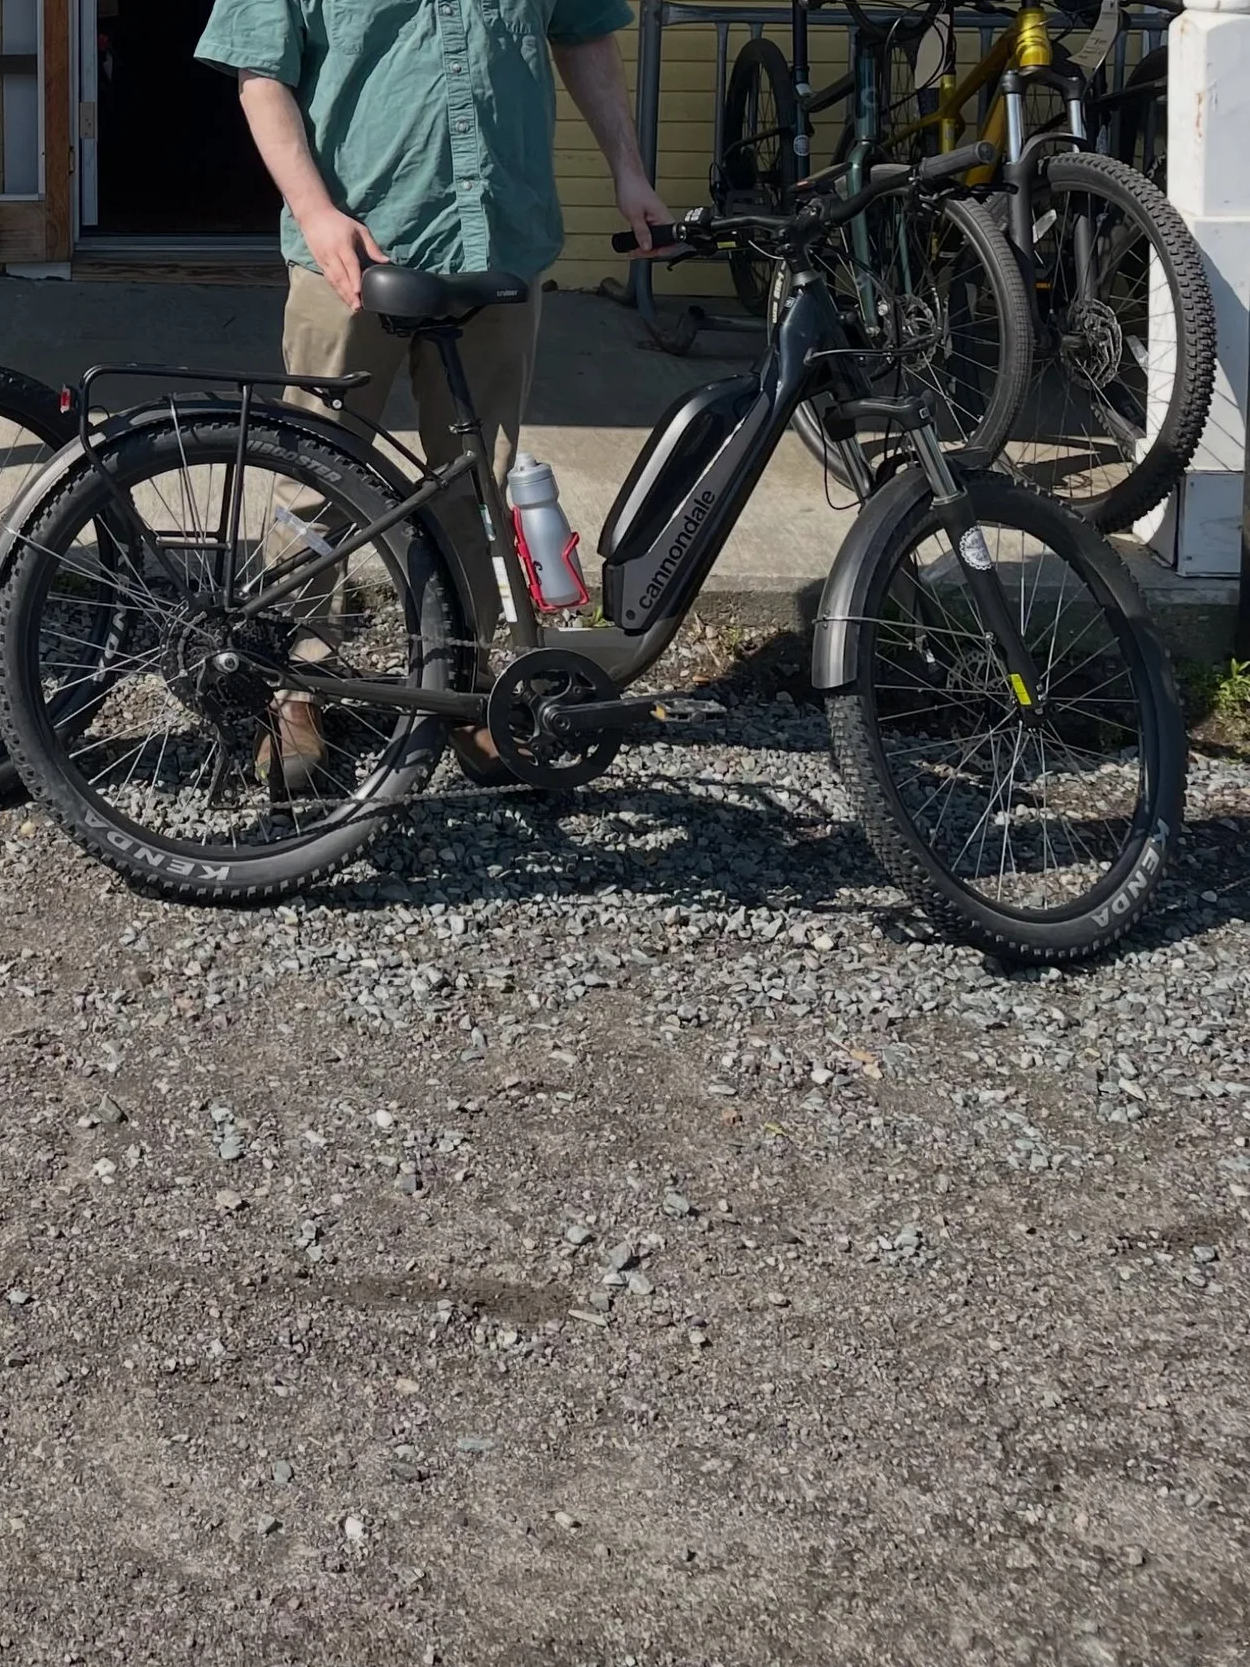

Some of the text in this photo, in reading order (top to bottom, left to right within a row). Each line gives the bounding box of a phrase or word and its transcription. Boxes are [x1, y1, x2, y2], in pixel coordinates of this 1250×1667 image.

[639, 491, 715, 610] cannondale
[84, 809, 230, 881] KENDA
[1091, 818, 1170, 927] KENDA
